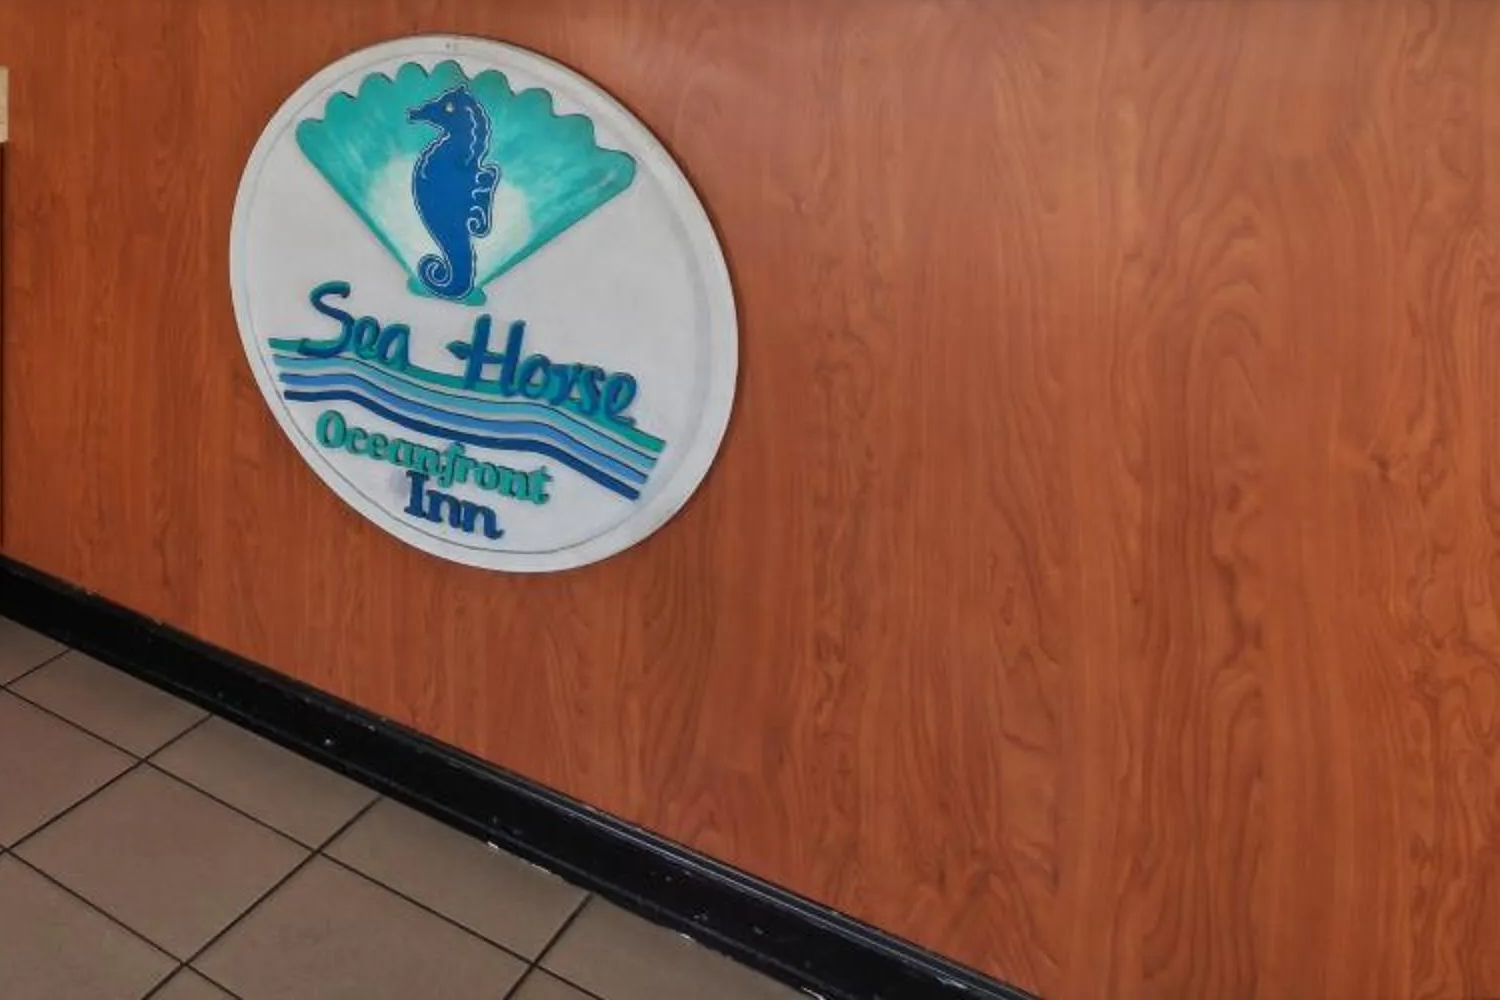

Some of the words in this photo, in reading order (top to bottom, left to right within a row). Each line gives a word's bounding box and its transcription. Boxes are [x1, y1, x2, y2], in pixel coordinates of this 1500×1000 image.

[298, 280, 411, 367] Sea
[446, 313, 638, 425] Horse
[315, 409, 554, 504] Oceanfront
[403, 470, 504, 541] Inn
